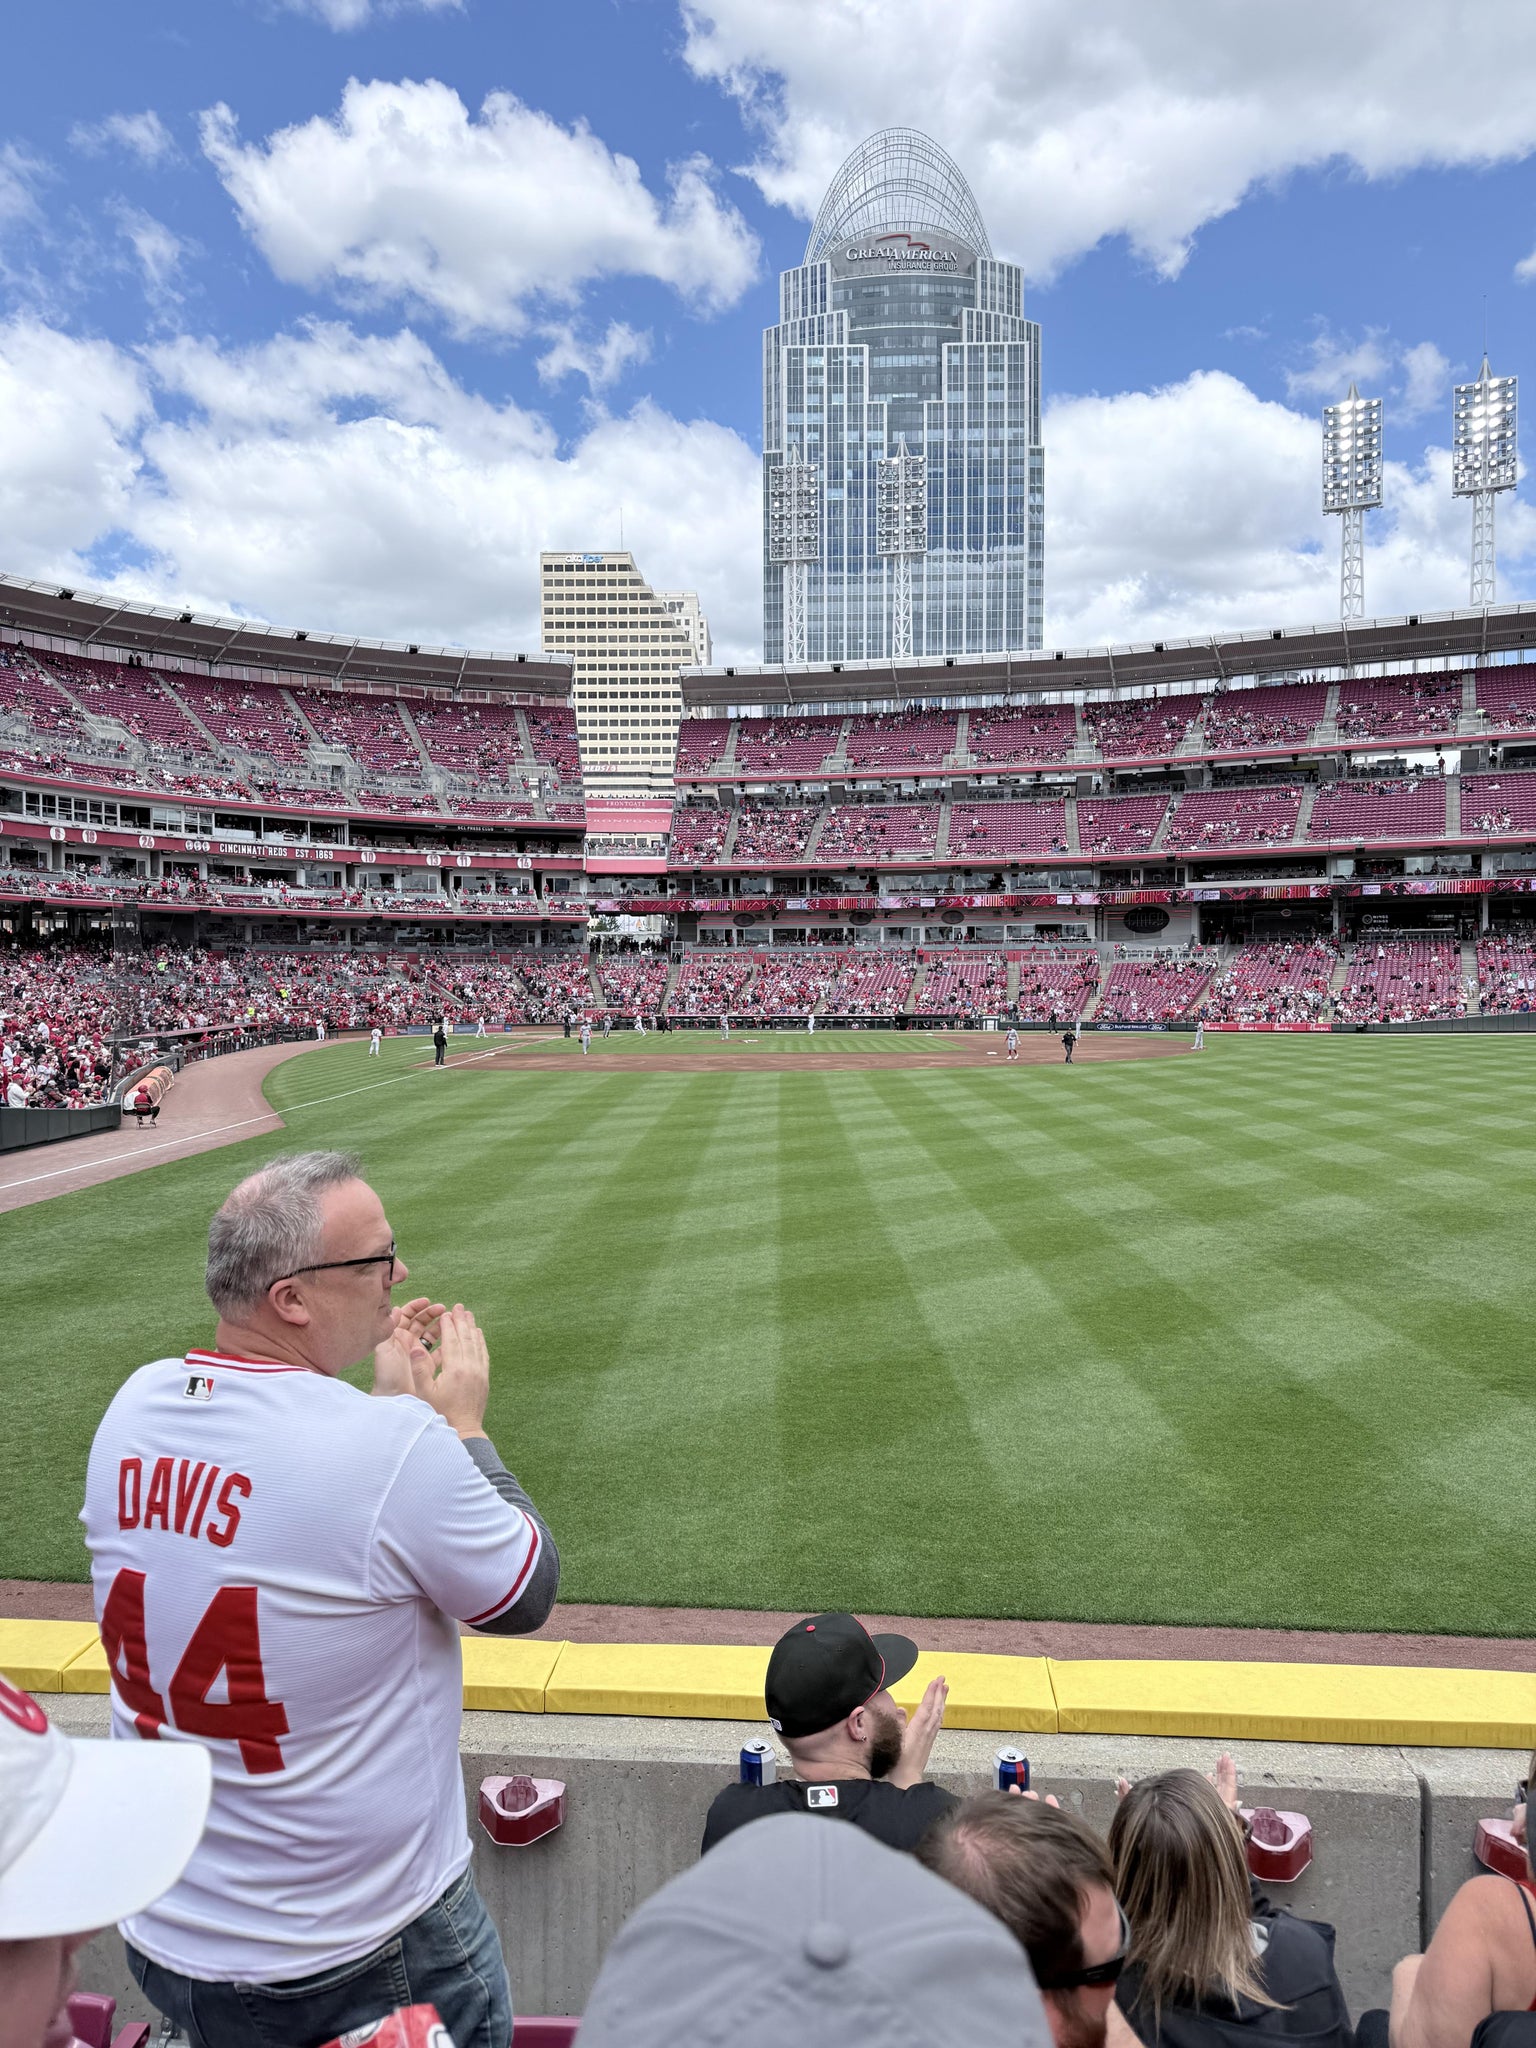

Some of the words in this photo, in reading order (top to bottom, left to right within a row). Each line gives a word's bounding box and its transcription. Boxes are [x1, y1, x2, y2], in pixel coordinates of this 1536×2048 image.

[846, 247, 894, 261] GREAT
[887, 249, 958, 262] AMERICAN
[888, 262, 931, 271] INSURANCE
[934, 262, 959, 272] GROUP
[219, 843, 265, 856] CINCINNATI
[268, 846, 288, 857] REDS
[295, 848, 313, 859] EST.
[315, 849, 334, 860] 1869
[430, 854, 439, 866] 13
[459, 855, 469, 867] 11
[1263, 886, 1289, 899] HOME
[1290, 885, 1310, 898] RUN
[1435, 880, 1462, 894] HOME
[1465, 879, 1487, 893] RUN
[838, 898, 858, 909] HOME
[980, 895, 1003, 907] HOME
[1115, 891, 1139, 904] HOME
[1140, 890, 1159, 904] RUN
[709, 900, 730, 911] HOME
[118, 1457, 253, 1548] DAVIS
[101, 1568, 290, 1775] 44
